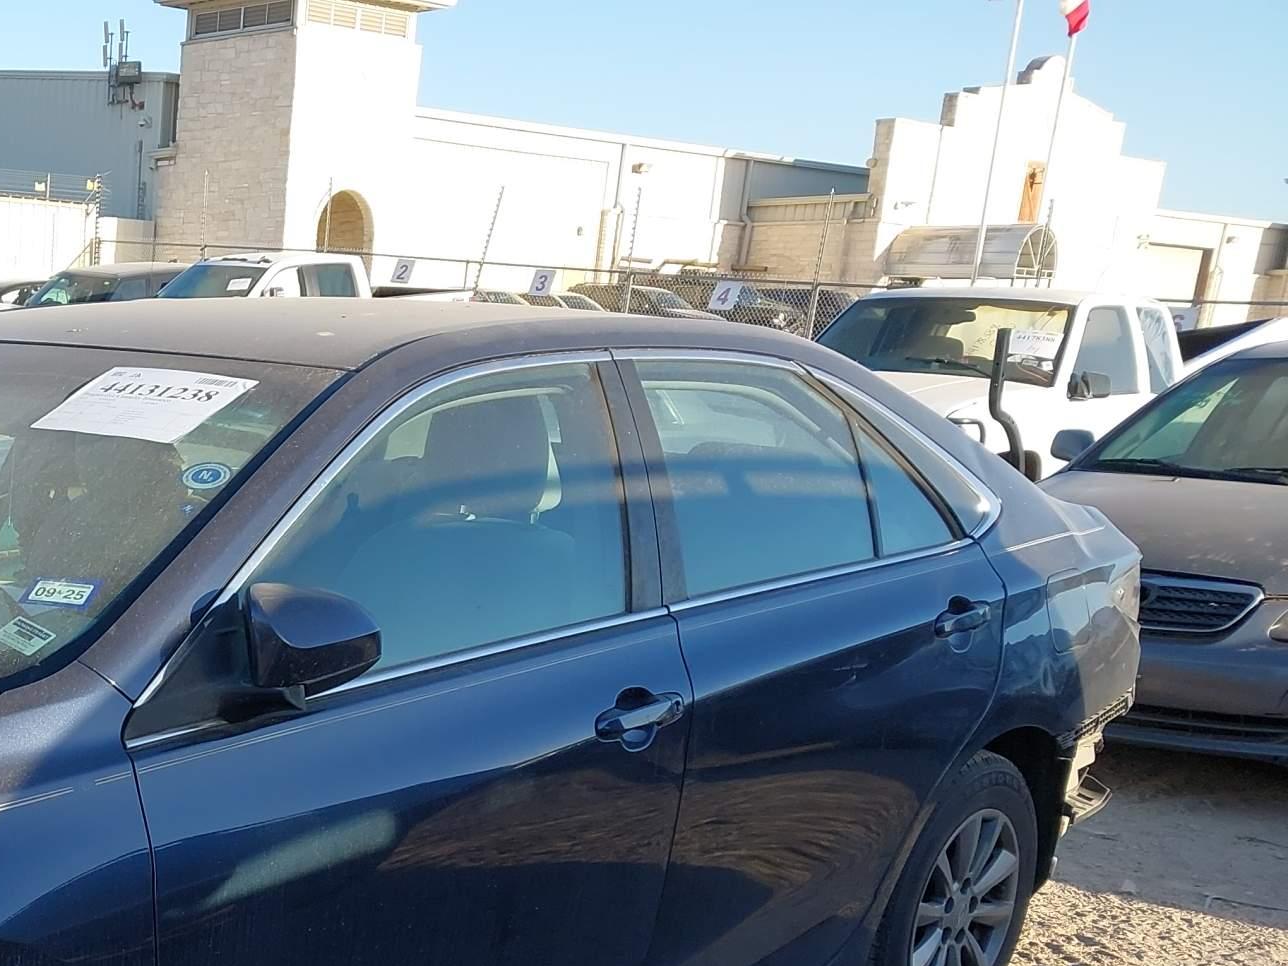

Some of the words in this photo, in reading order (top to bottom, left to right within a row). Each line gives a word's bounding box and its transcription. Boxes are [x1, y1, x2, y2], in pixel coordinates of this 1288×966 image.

[396, 264, 409, 280] 2
[535, 275, 548, 291] 3
[716, 287, 732, 305] 4
[101, 381, 220, 403] 44131238
[35, 586, 57, 598] 09
[63, 589, 86, 601] 25
